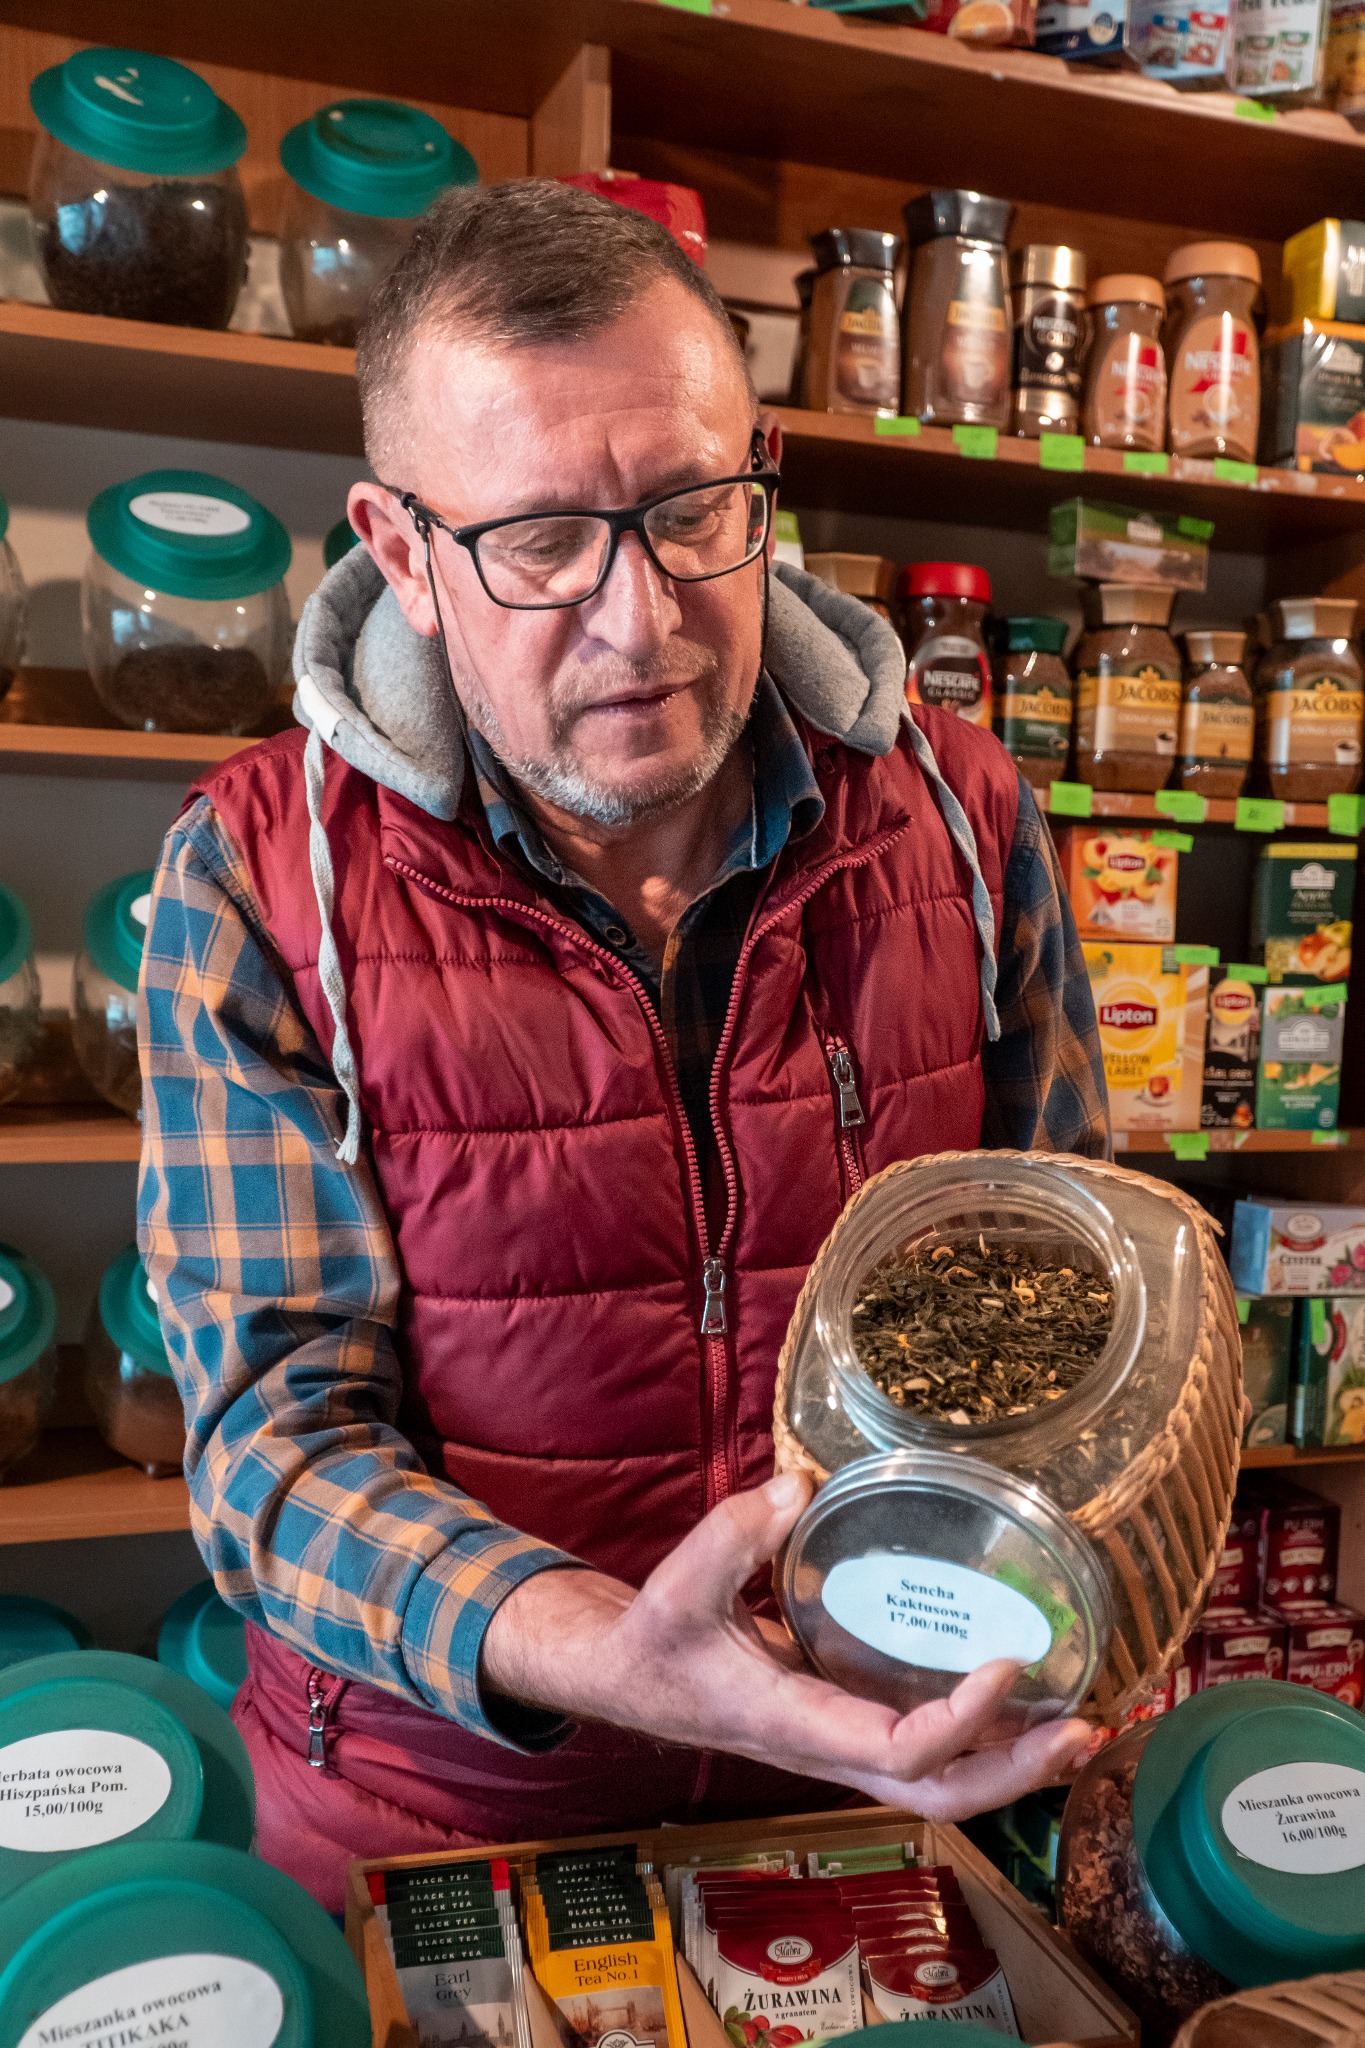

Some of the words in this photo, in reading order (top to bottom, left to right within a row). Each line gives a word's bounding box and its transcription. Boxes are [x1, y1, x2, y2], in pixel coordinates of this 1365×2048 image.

[928, 687, 975, 699] CLASSIC
[1117, 683, 1180, 701] JACOBS
[1019, 699, 1071, 716] JACOBS
[1291, 695, 1362, 712] JACOBS
[1202, 711, 1249, 725] JACOBS
[1110, 858, 1143, 869] Lipton
[1216, 998, 1248, 1008] Lipton
[1103, 1008, 1153, 1026] Lipton
[1104, 1054, 1151, 1063] YELLOW
[1108, 1066, 1143, 1076] LABEL
[901, 1578, 955, 1600] Sencha
[886, 1593, 971, 1621] Kaktusowa
[889, 1611, 969, 1640] 17,00/100g
[0, 1769, 50, 1783] erbata
[55, 1764, 122, 1778] owocowa
[0, 1783, 86, 1801] Hiszpańska
[91, 1781, 128, 1794] Pom.
[1238, 1794, 1304, 1812] Mieszanka
[1307, 1788, 1361, 1803] owocowa
[24, 1800, 103, 1818] 15,00/100g
[1276, 1808, 1337, 1826] Żurawina
[1282, 1825, 1348, 1844] 16,00/100g
[558, 1863, 591, 1872] BLACK
[597, 1859, 616, 1868] TEA
[409, 1876, 444, 1886] BLACK
[450, 1873, 469, 1881] TEA
[410, 1892, 445, 1901] BLACK
[451, 1889, 470, 1897] TEA
[411, 1904, 446, 1914] BLACK
[452, 1901, 472, 1909] TEA
[568, 1907, 602, 1916] BLACK
[608, 1904, 627, 1912] TEA
[415, 1919, 450, 1930] BLACK
[456, 1917, 476, 1925] TEA
[571, 1920, 605, 1929] BLACK
[612, 1917, 631, 1925] TEA
[417, 1937, 453, 1947] BLACK
[459, 1934, 479, 1942] TEA
[572, 1935, 607, 1945] BLACK
[420, 1952, 455, 1962] BLACK
[461, 1950, 482, 1958] TEA
[573, 1952, 639, 1973] English
[434, 1969, 471, 1987] Earl
[575, 1974, 602, 1988] Tea
[436, 1987, 472, 2001] Grey
[744, 1988, 842, 2012] ŻURAWINA
[38, 2007, 136, 2046] Mieszanka
[142, 1979, 222, 2015] owocowa
[781, 2009, 817, 2020] granatem
